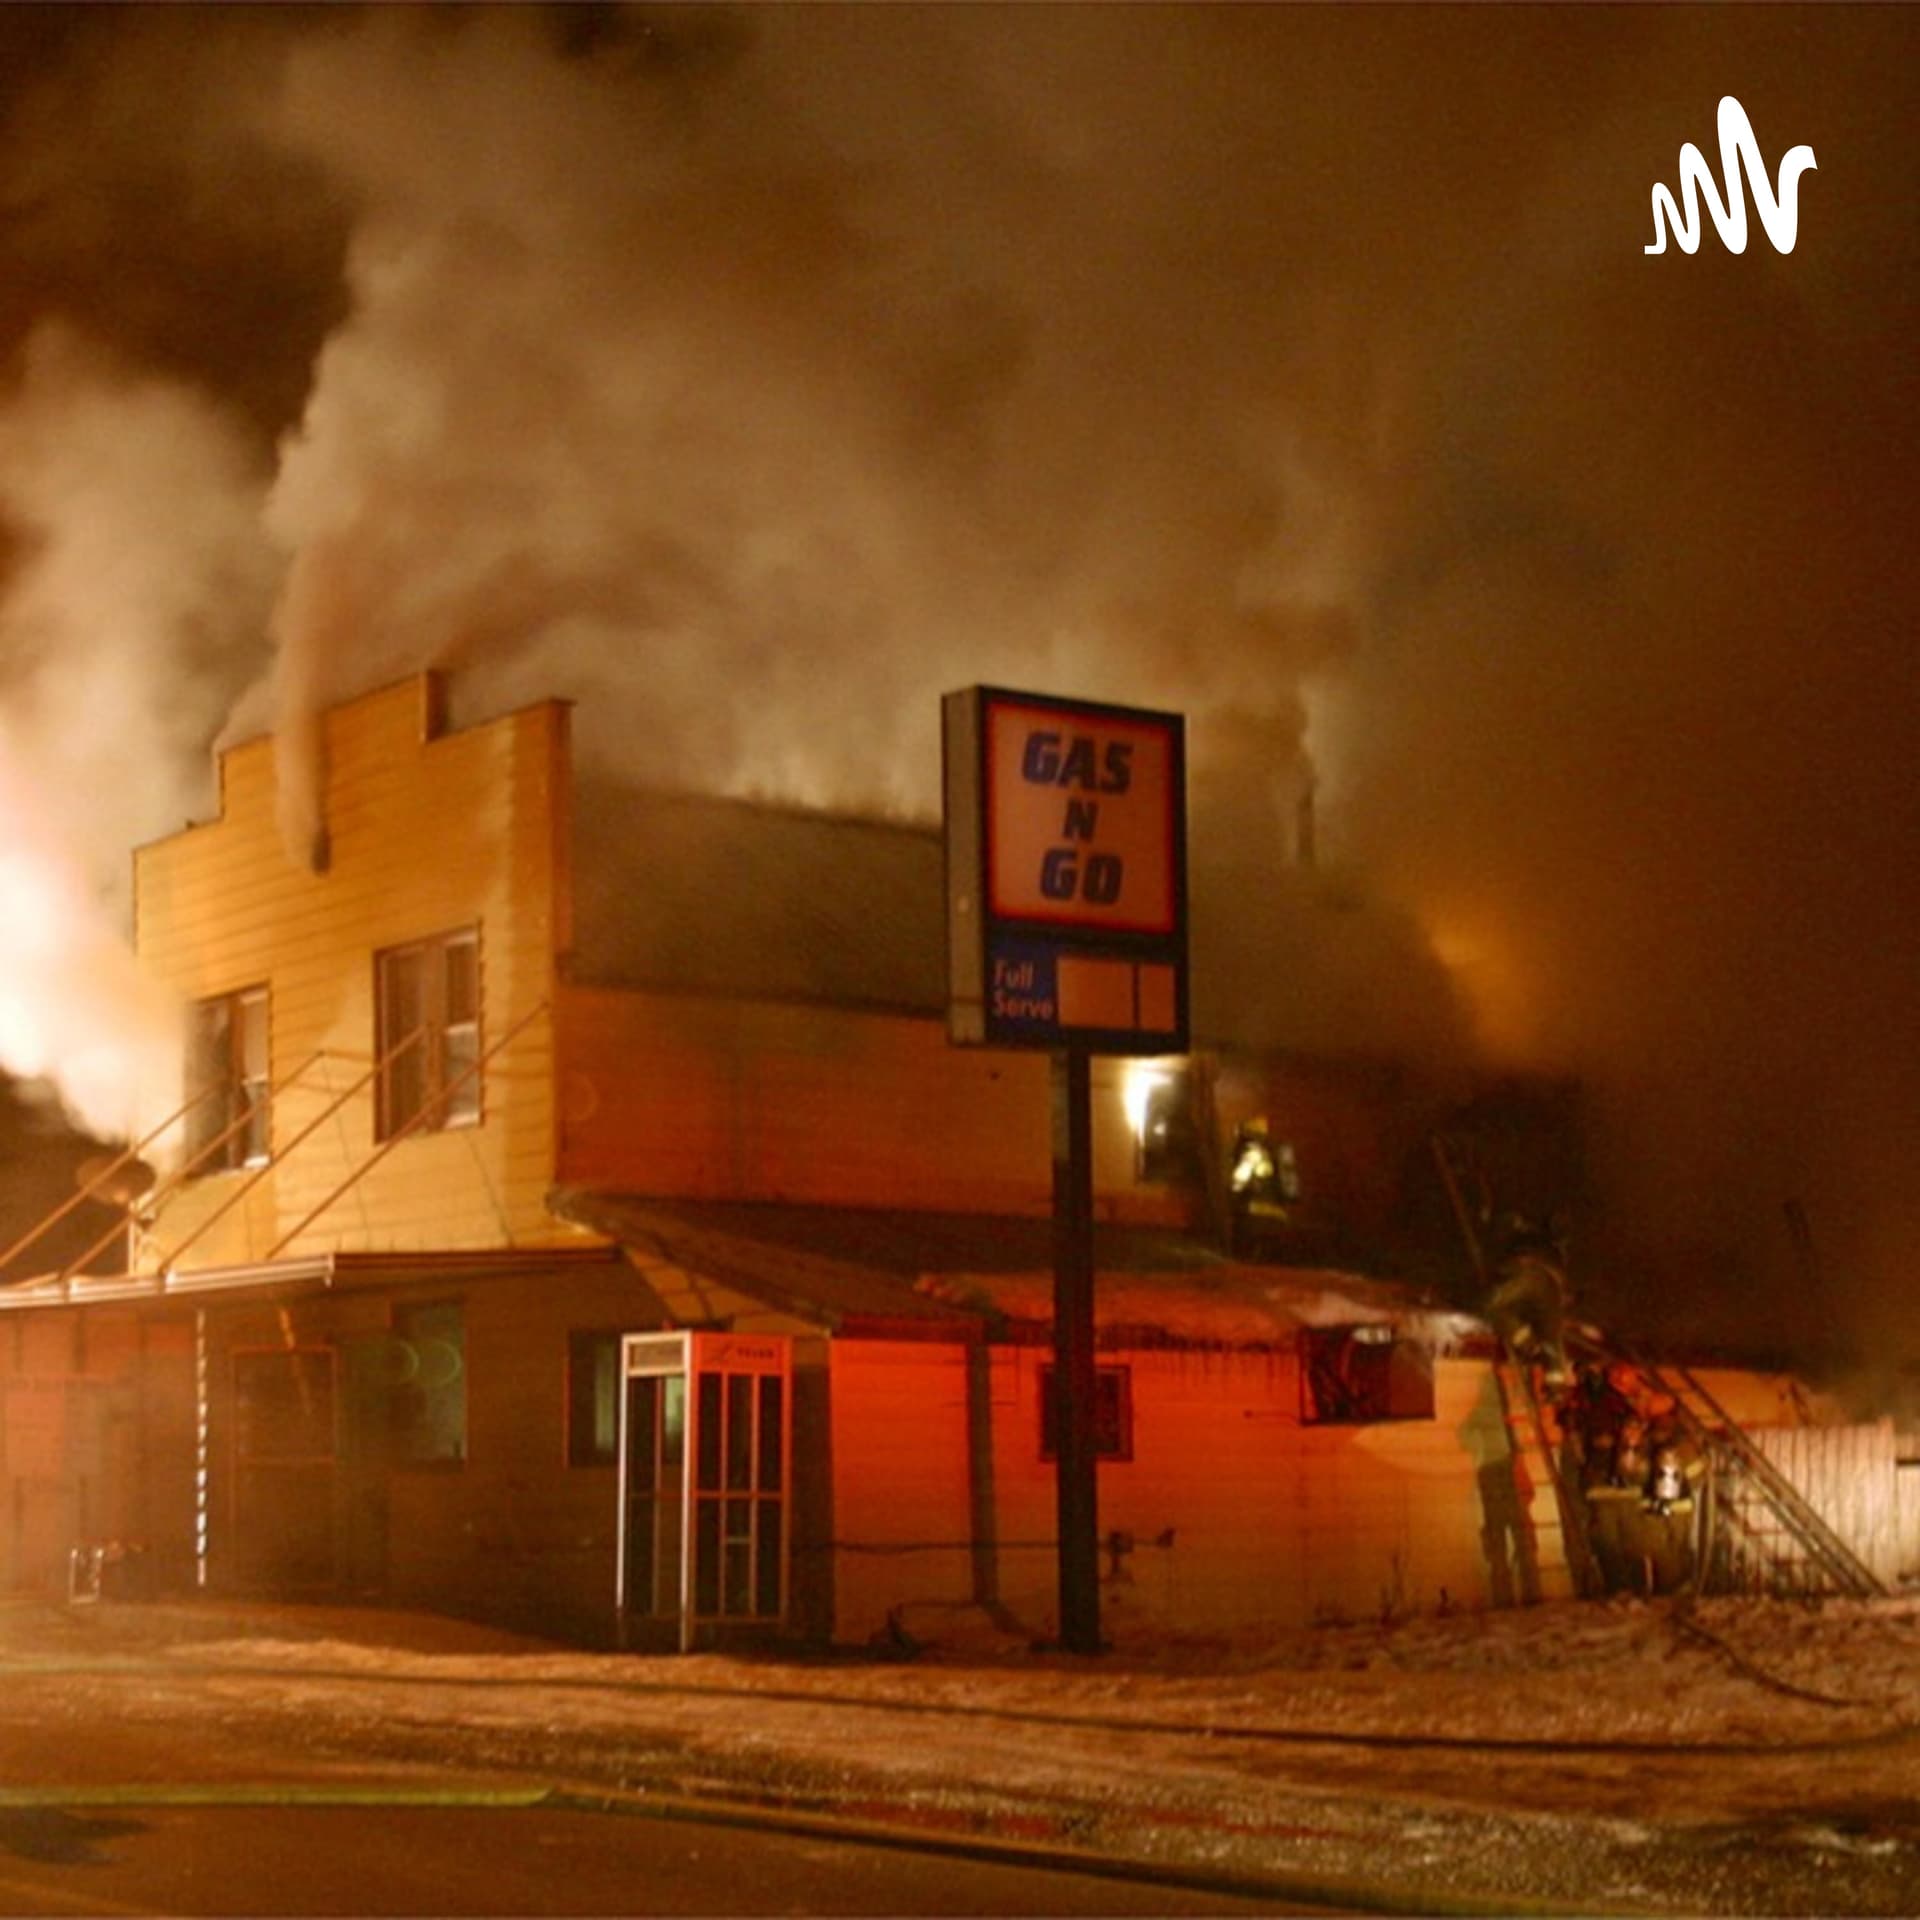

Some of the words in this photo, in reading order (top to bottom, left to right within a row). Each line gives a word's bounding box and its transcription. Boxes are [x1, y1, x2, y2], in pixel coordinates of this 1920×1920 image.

[1022, 731, 1133, 795] GAS
[1062, 799, 1098, 842] N
[1039, 848, 1123, 906] GO
[994, 959, 1033, 988] Full
[994, 989, 1054, 1019] Serve
